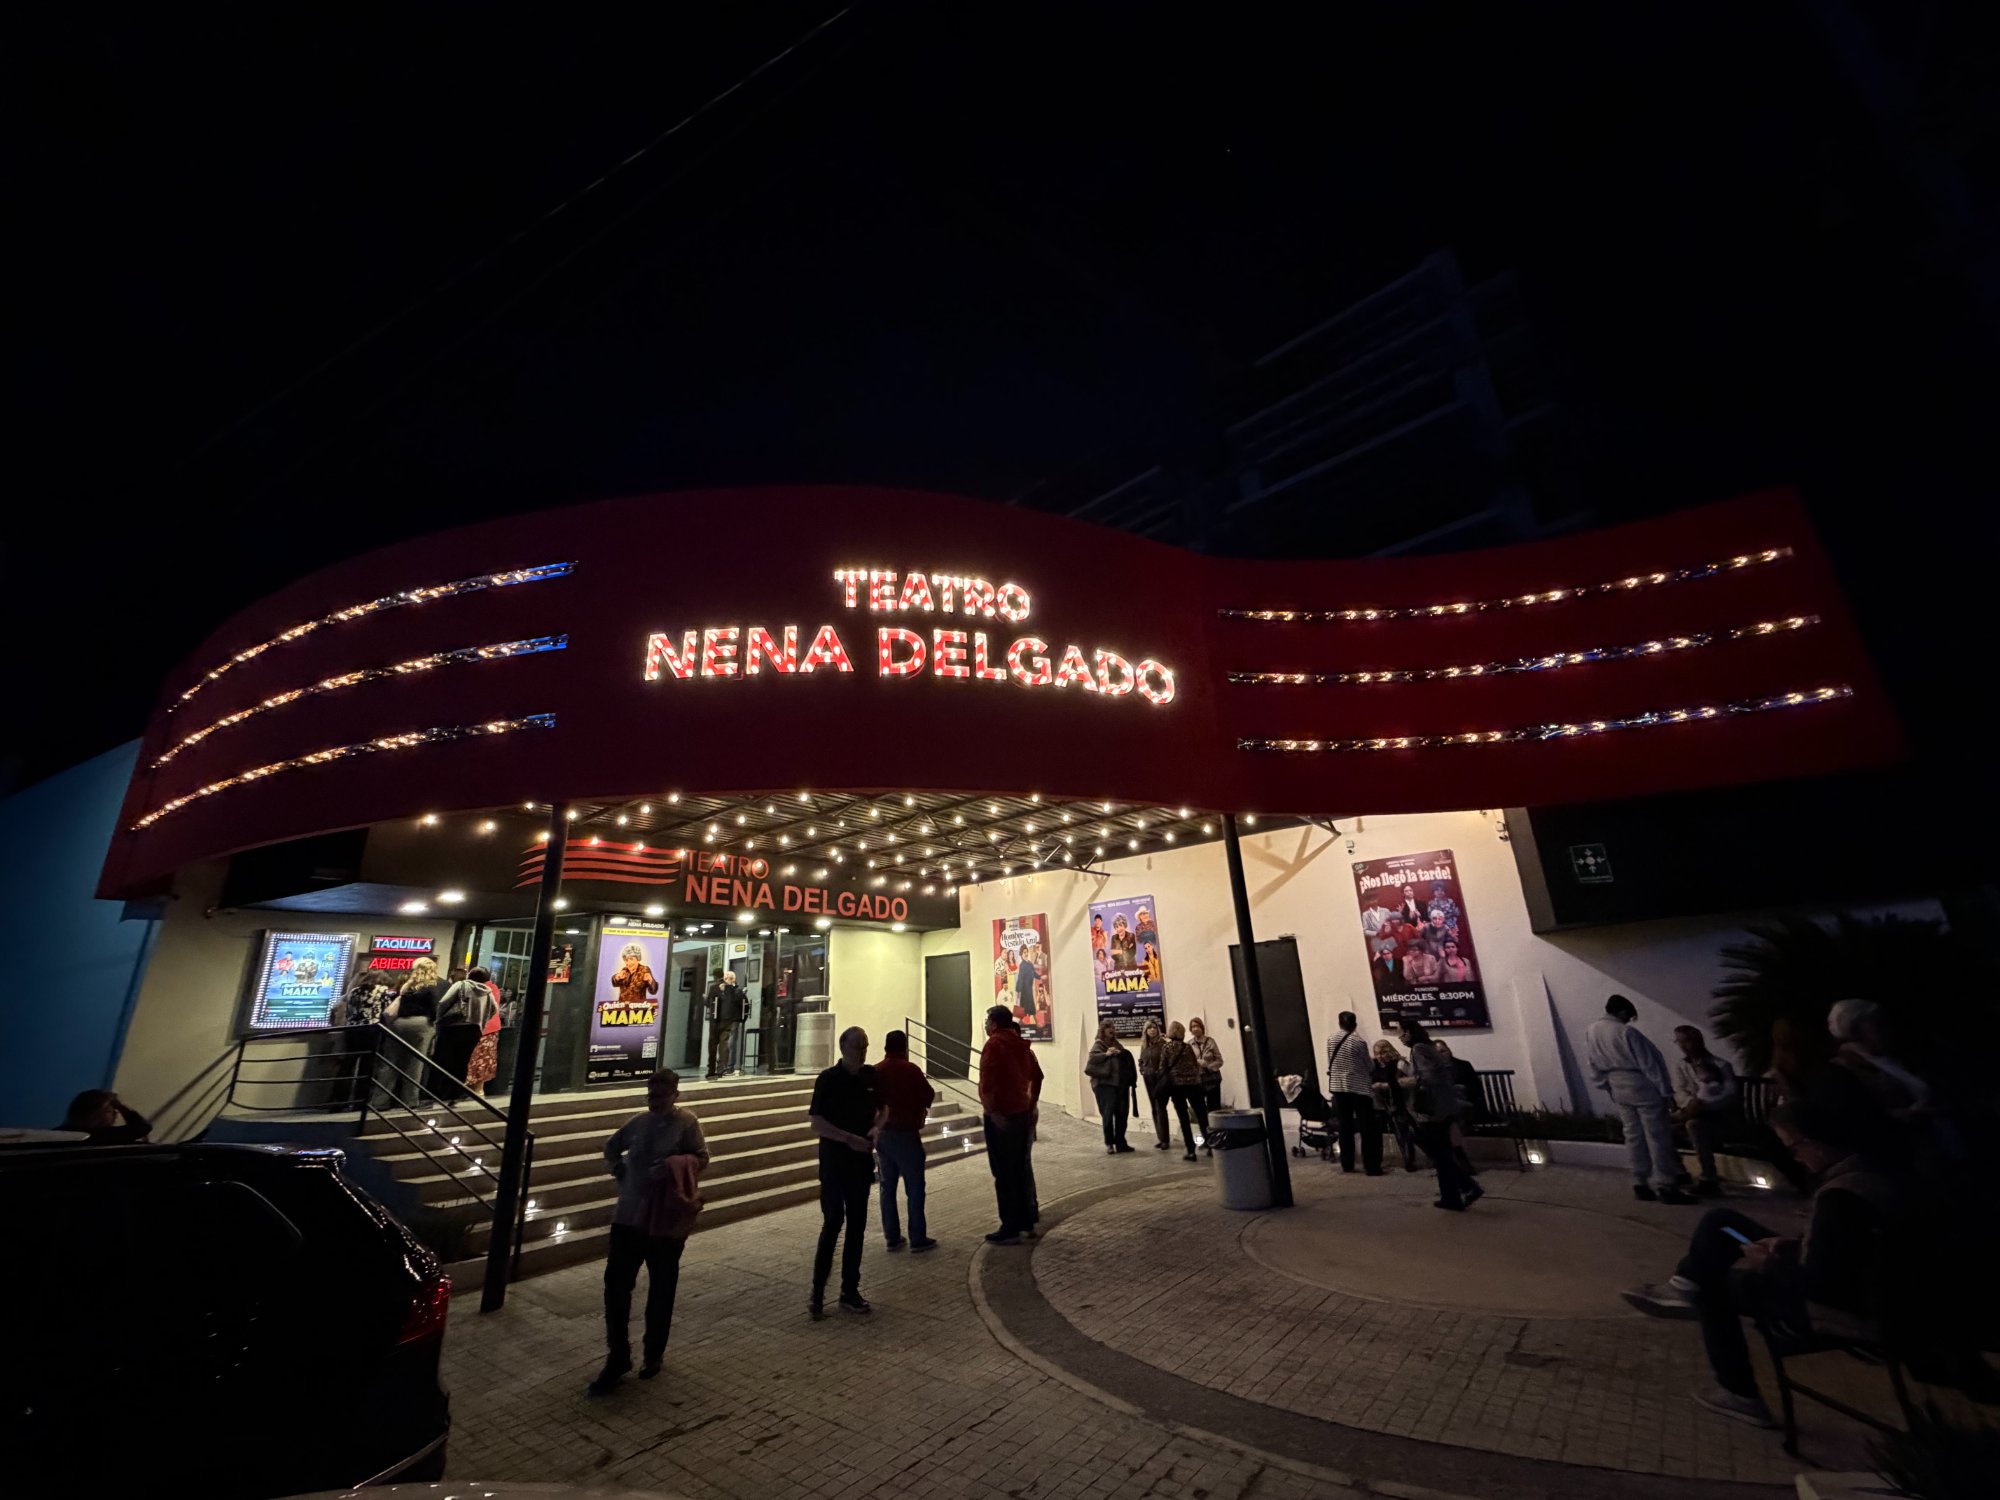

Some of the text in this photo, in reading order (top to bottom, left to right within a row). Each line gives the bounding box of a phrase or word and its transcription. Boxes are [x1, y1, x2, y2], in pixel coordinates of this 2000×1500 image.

[834, 569, 1030, 622] TEATRO
[645, 625, 1176, 705] NENA DELGADO
[685, 848, 770, 880] TEATRO
[1380, 869, 1406, 888] llegó
[1405, 869, 1418, 883] la
[1417, 865, 1452, 881] tarde!
[685, 874, 908, 921] NENA DELGADO
[374, 938, 432, 950] TAQUILLA
[368, 957, 415, 970] ABIERT
[1439, 991, 1475, 1001] 8:30PM
